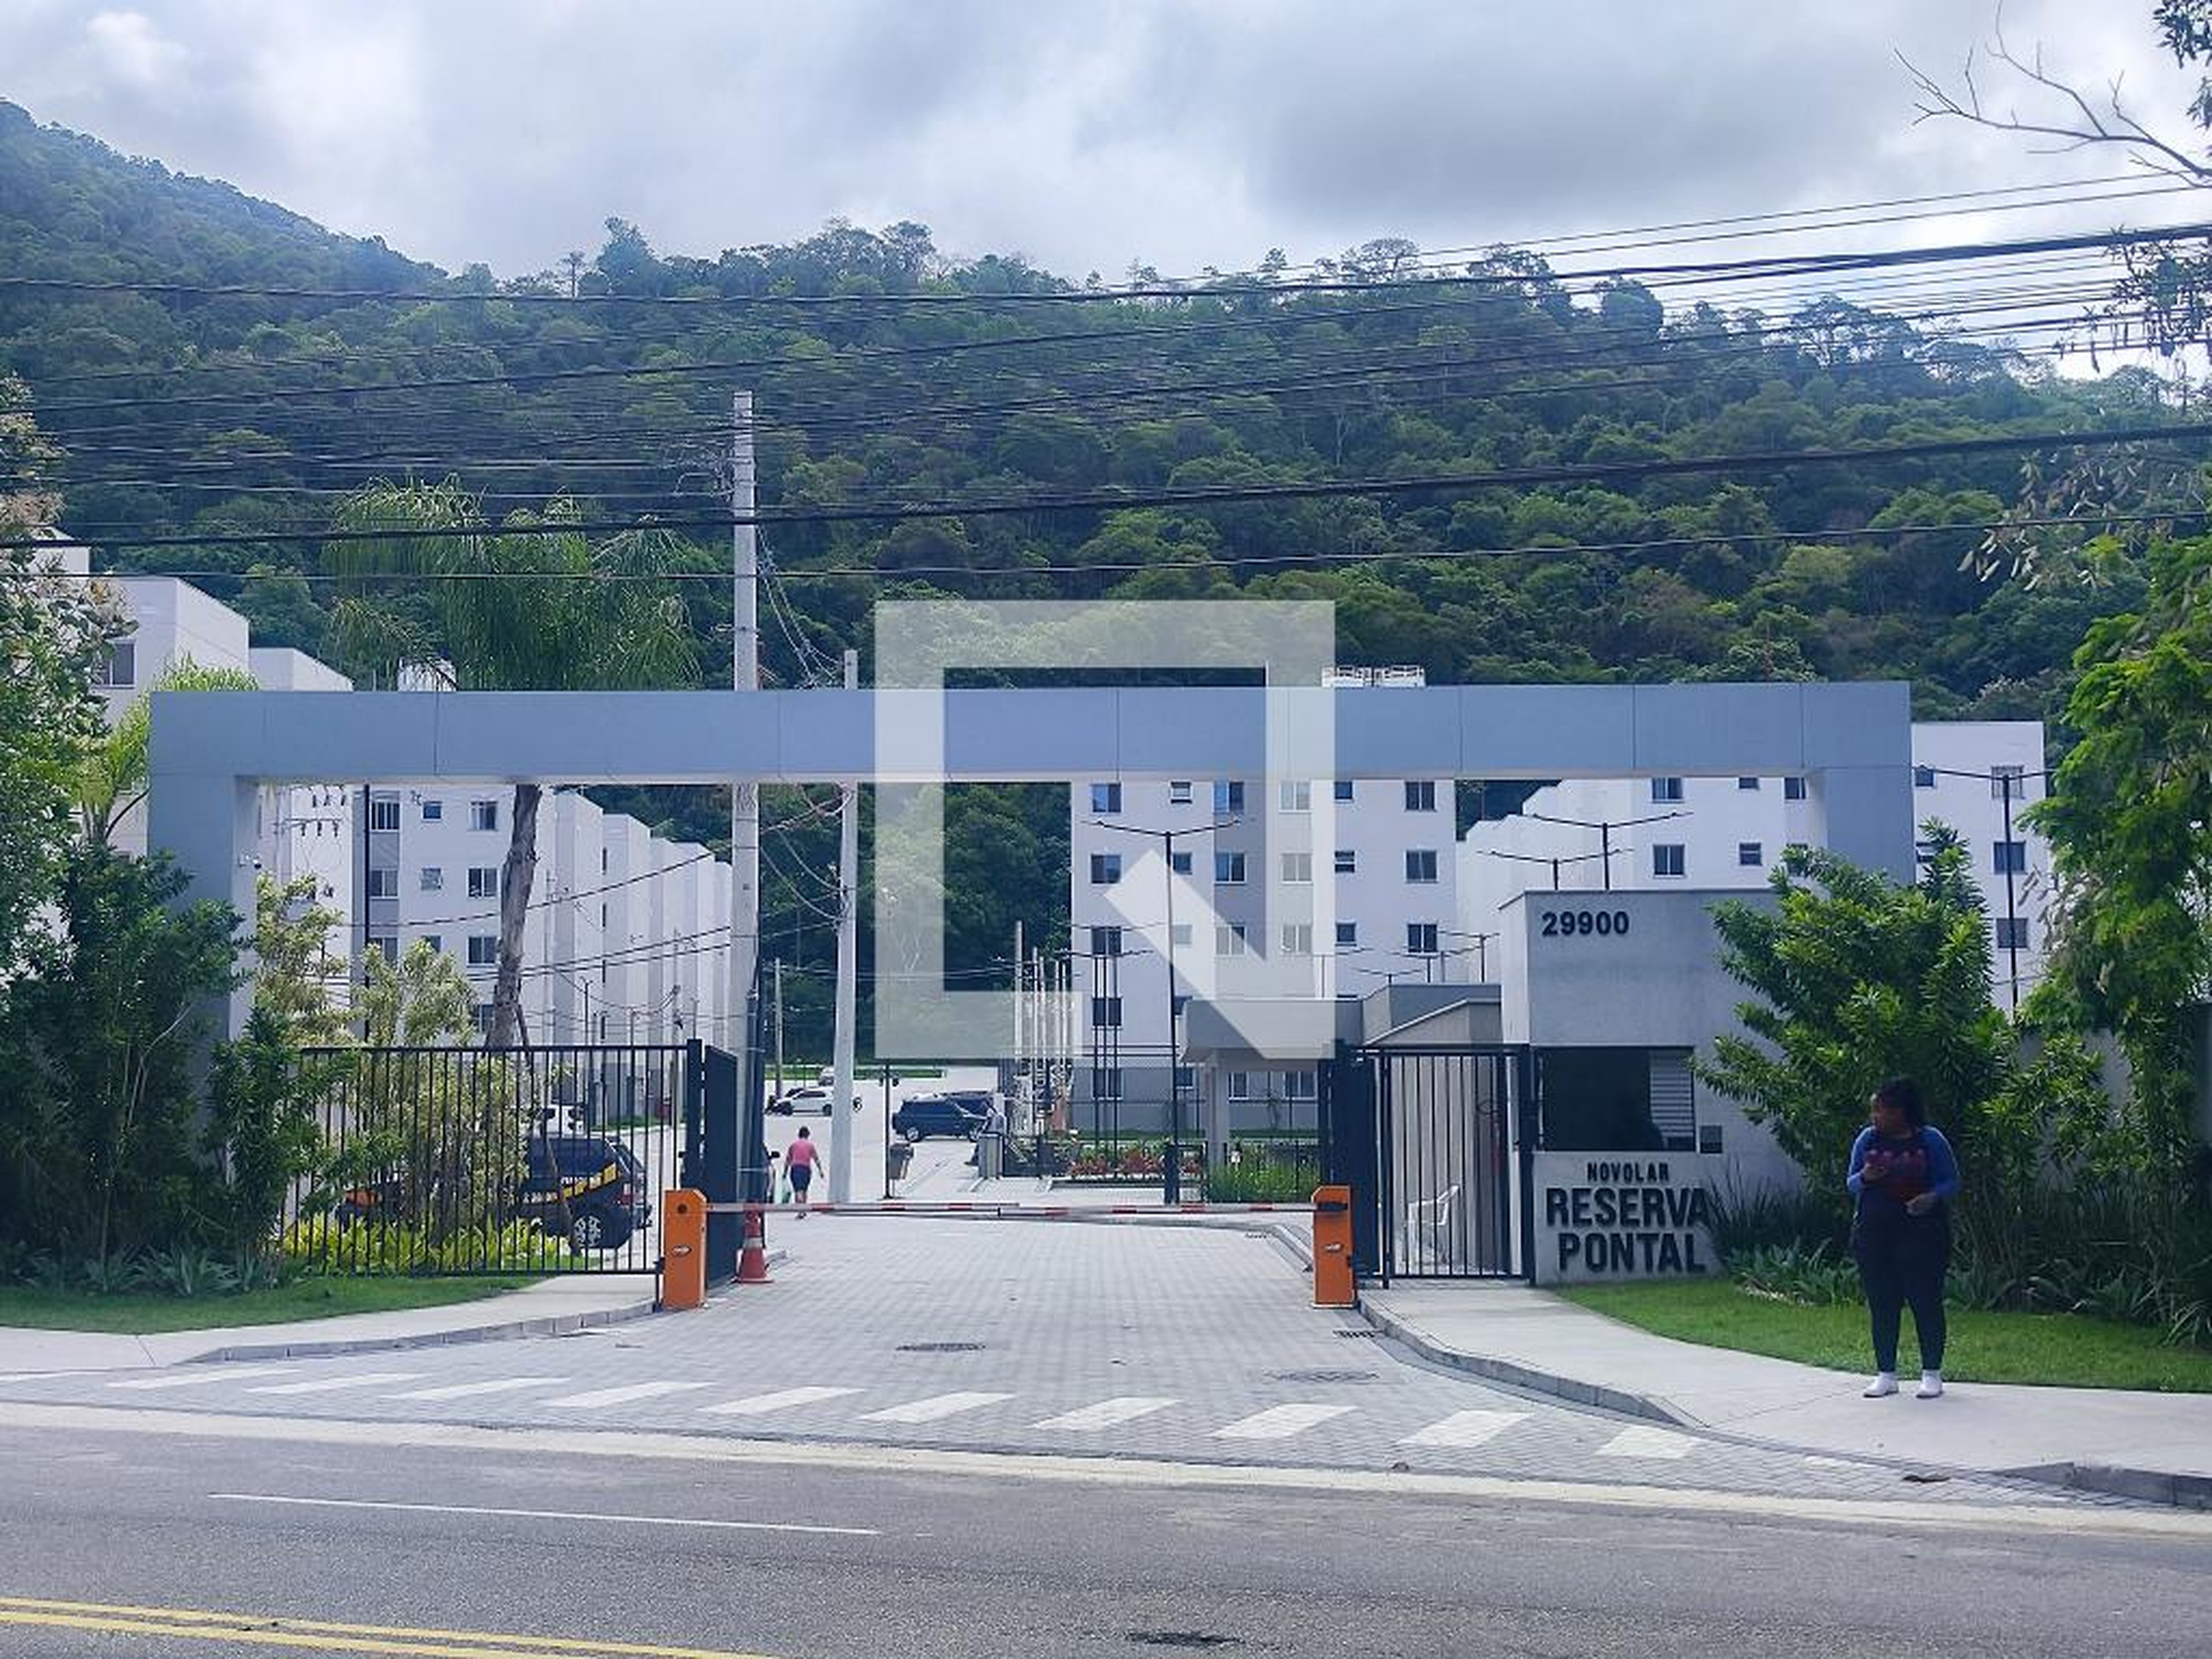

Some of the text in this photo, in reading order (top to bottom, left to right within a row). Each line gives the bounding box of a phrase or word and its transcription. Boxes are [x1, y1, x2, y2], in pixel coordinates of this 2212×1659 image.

[1542, 911, 1629, 935] 29900
[1587, 1162, 1669, 1181] NOVOLAR
[1546, 1187, 1711, 1227] RESERVA
[1558, 1233, 1707, 1272] PONTAL
